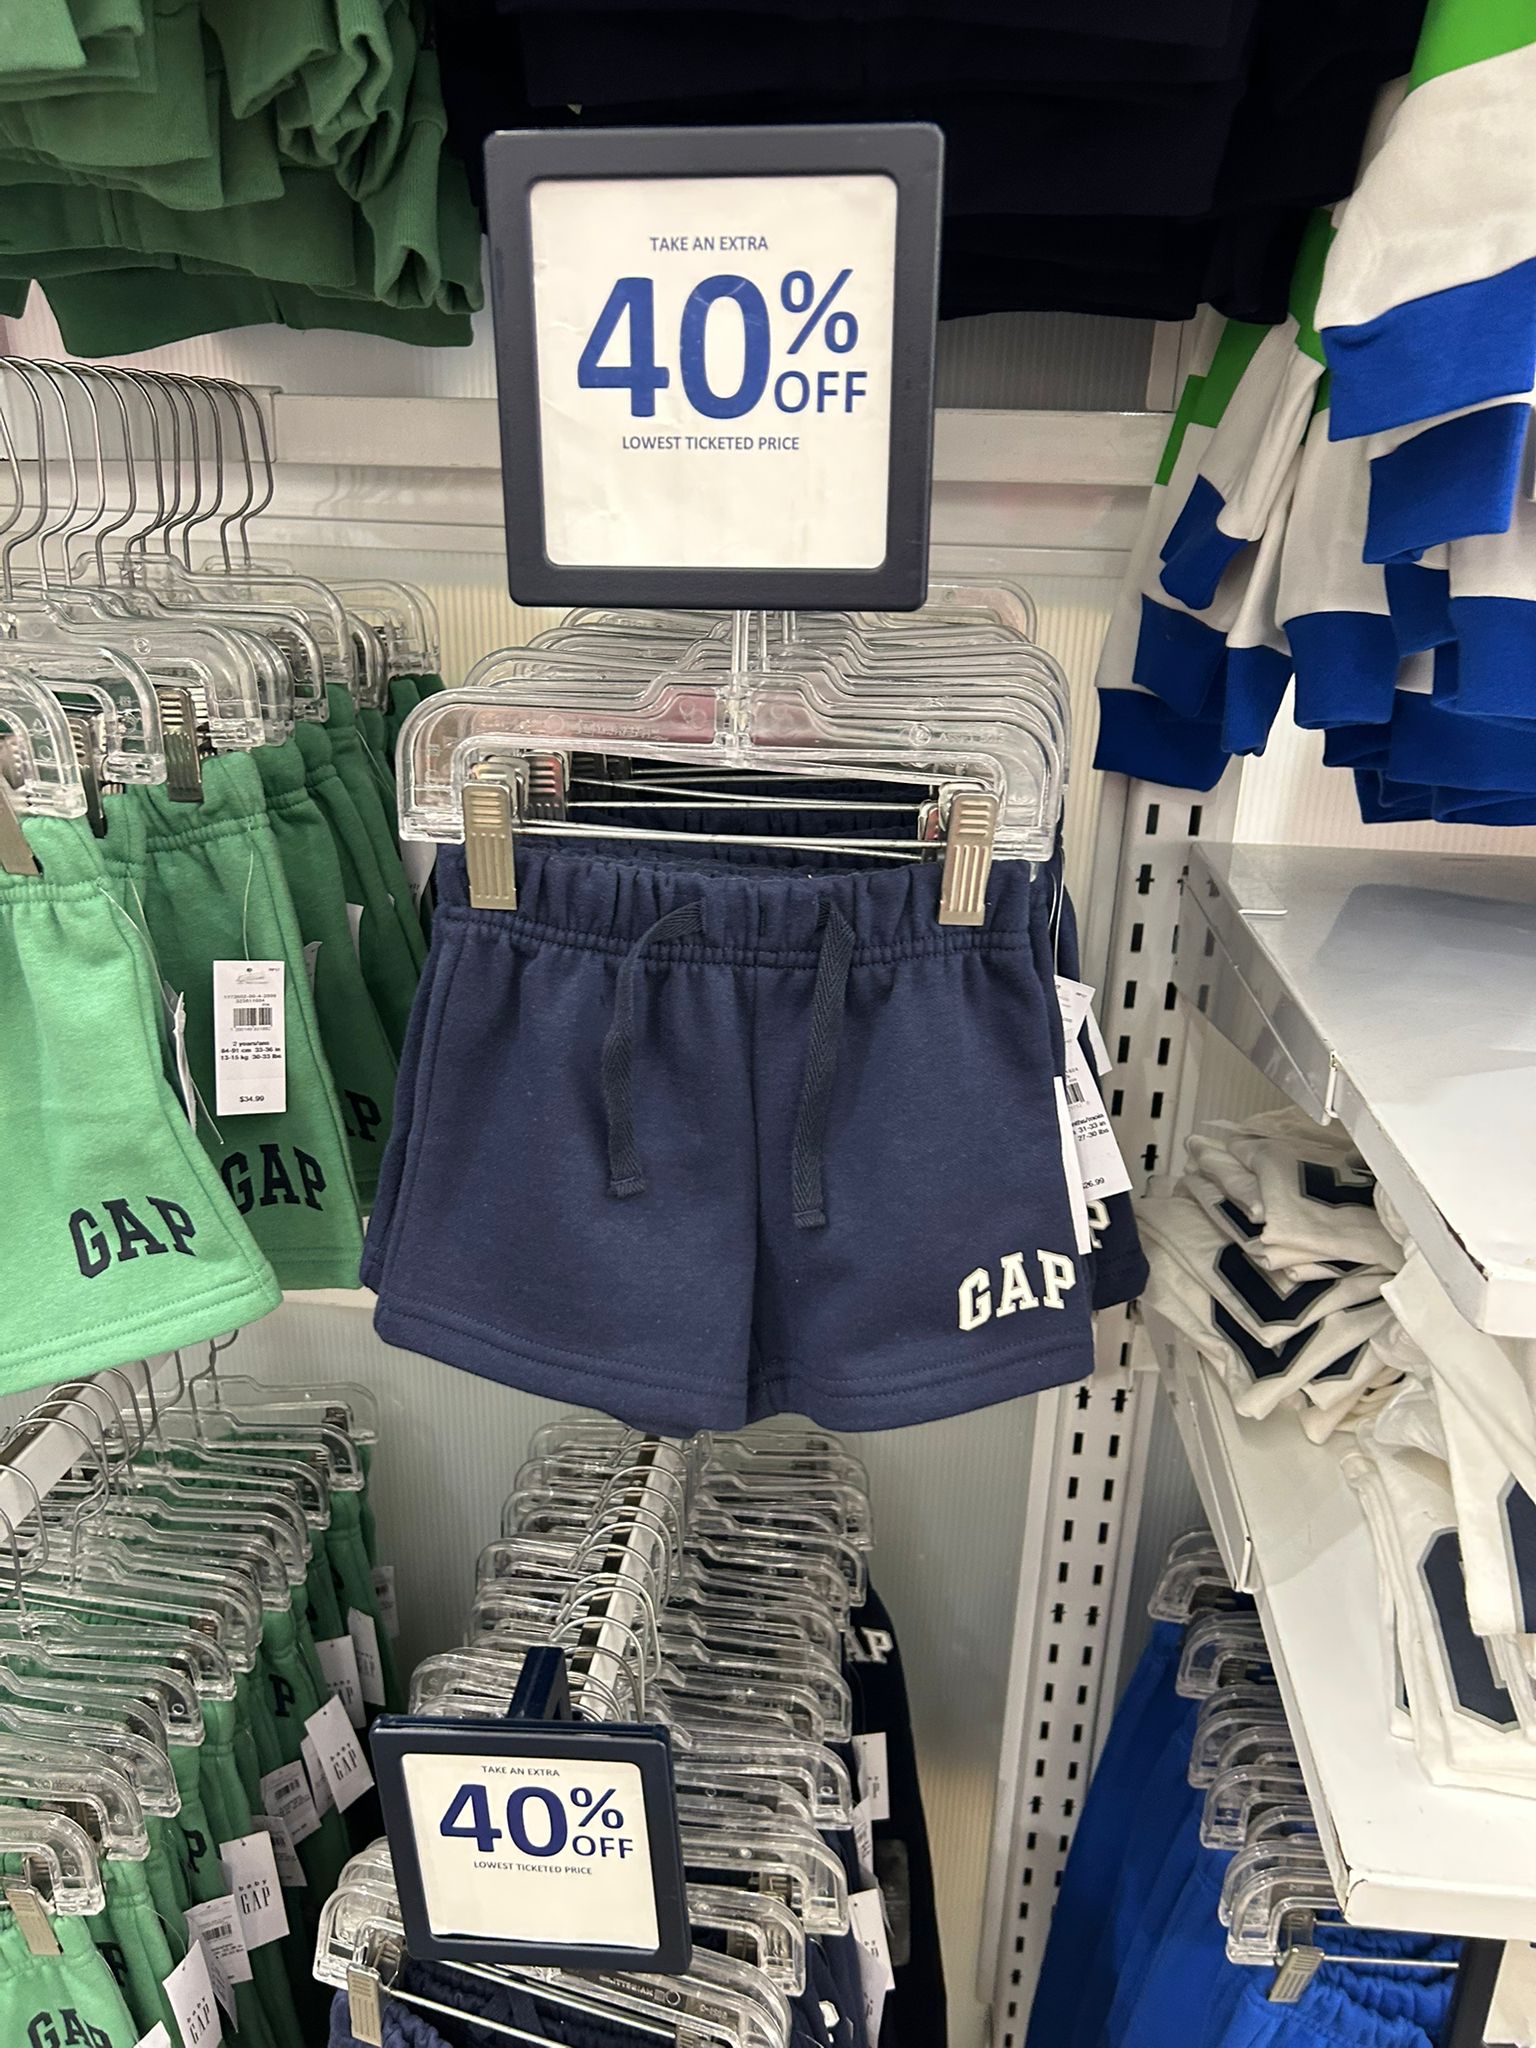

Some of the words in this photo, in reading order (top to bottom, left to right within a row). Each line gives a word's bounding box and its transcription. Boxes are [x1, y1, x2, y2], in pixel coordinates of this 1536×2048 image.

[650, 236, 688, 251] TAKE
[692, 236, 715, 250] AN
[719, 236, 768, 250] EXTRA
[577, 269, 859, 420] 40%
[774, 370, 867, 413] OFF
[622, 436, 682, 450] LOWEST
[685, 436, 754, 450] TICKETED
[758, 436, 800, 450] PRICE
[1078, 1122, 1098, 1133] 31-33
[1098, 1128, 1110, 1136] lbs
[220, 1143, 327, 1216] GAP
[68, 1195, 197, 1279] GAP
[958, 1249, 1077, 1331] GAP
[844, 1626, 894, 1664] AP
[333, 1748, 358, 1781] GAP
[482, 1765, 507, 1774] TAKE
[510, 1767, 525, 1776] AN
[527, 1767, 560, 1777] EXTRA
[439, 1783, 624, 1858] 40%
[572, 1835, 634, 1859] OFF
[473, 1861, 513, 1871] LOWEST
[516, 1863, 562, 1874] TICKETED
[564, 1866, 593, 1875] PRICE
[238, 1880, 267, 1892] baby
[240, 1886, 271, 1915] GAP
[189, 2003, 210, 2044] GAP
